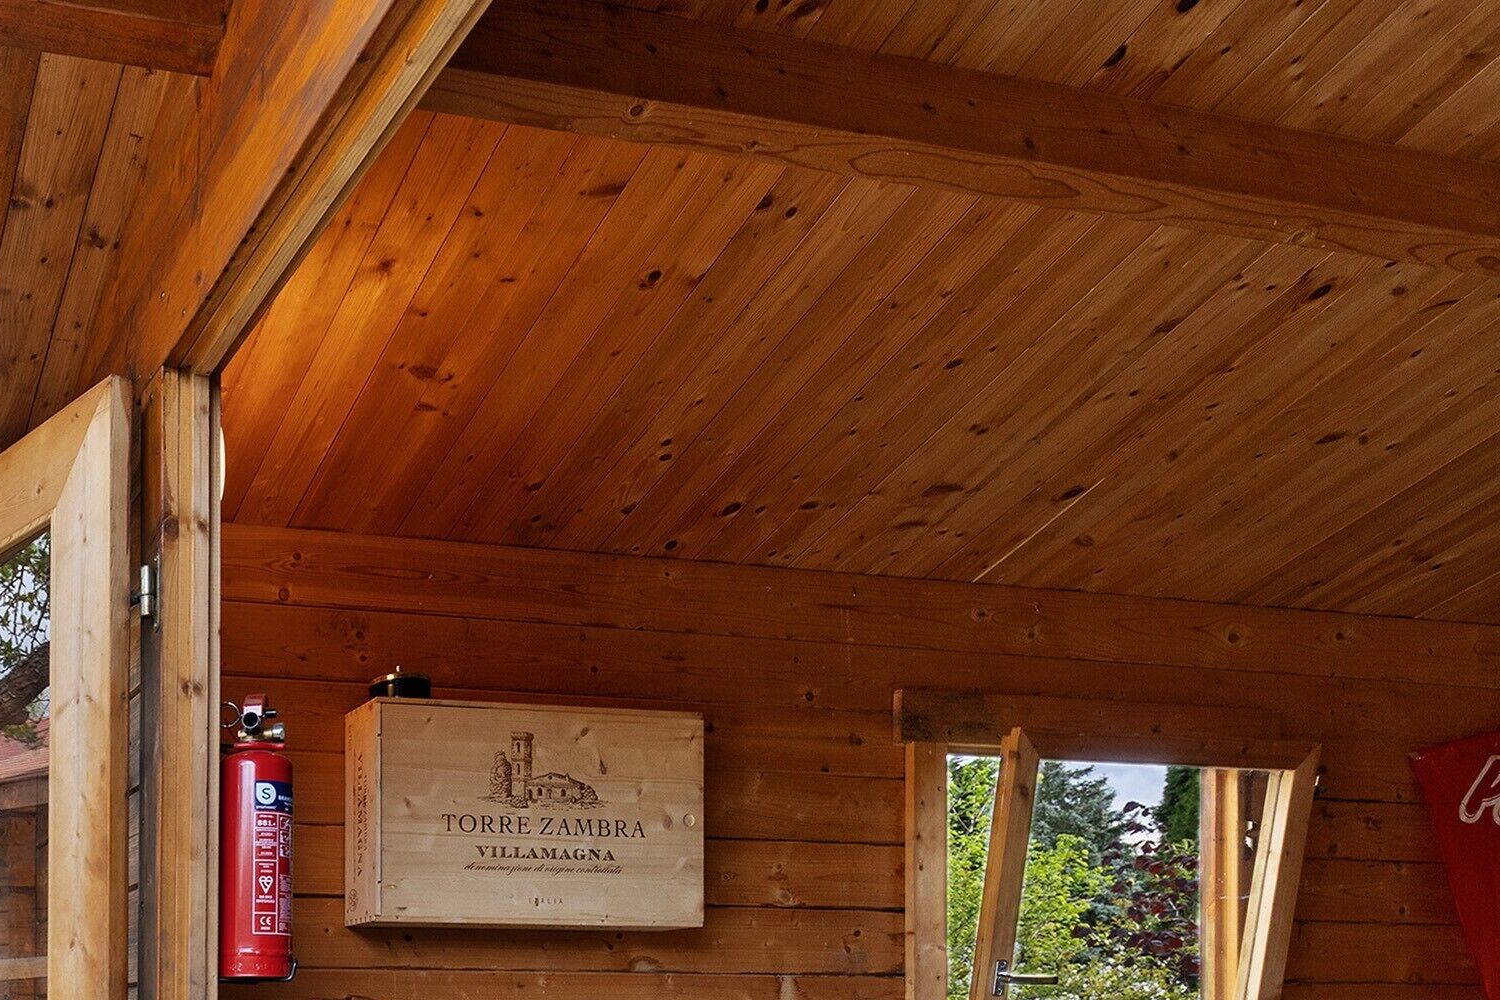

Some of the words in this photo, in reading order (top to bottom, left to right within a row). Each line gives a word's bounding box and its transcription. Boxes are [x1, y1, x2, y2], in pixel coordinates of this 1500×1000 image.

[441, 813, 531, 835] TORRE
[539, 817, 646, 839] ZAMBRA
[475, 845, 617, 862] VILLAMAGNA
[463, 861, 532, 876] denominazione
[533, 863, 546, 872] di
[545, 865, 575, 877] origine
